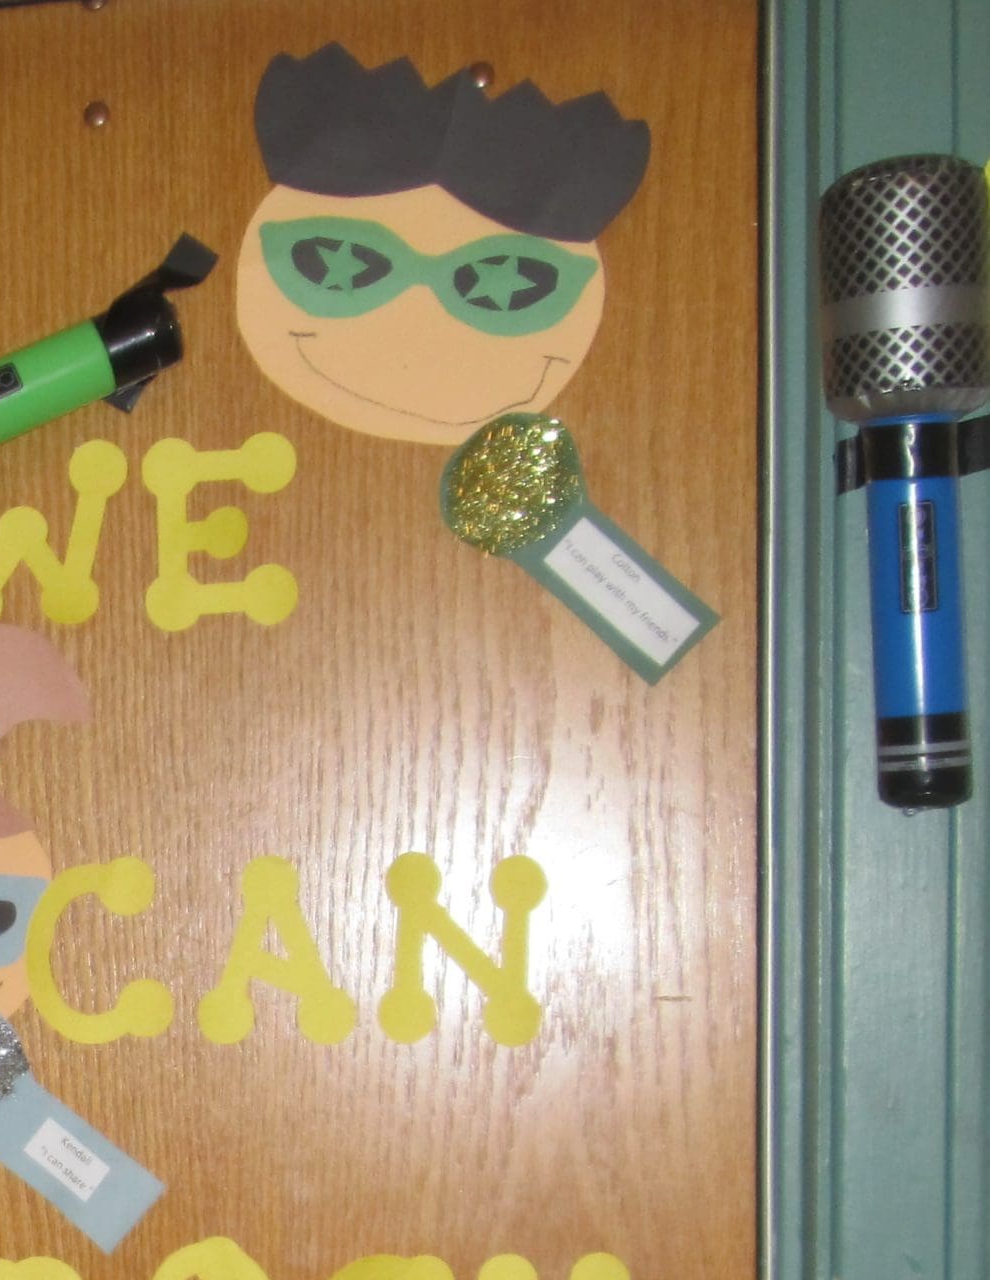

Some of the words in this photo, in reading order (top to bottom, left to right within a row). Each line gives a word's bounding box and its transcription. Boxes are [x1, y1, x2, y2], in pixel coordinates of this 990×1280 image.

[570, 548, 586, 567] can
[585, 562, 606, 585] play
[605, 578, 626, 601] with
[624, 598, 640, 616] my
[25, 851, 548, 1048] CAN
[46, 1154, 64, 1170] can
